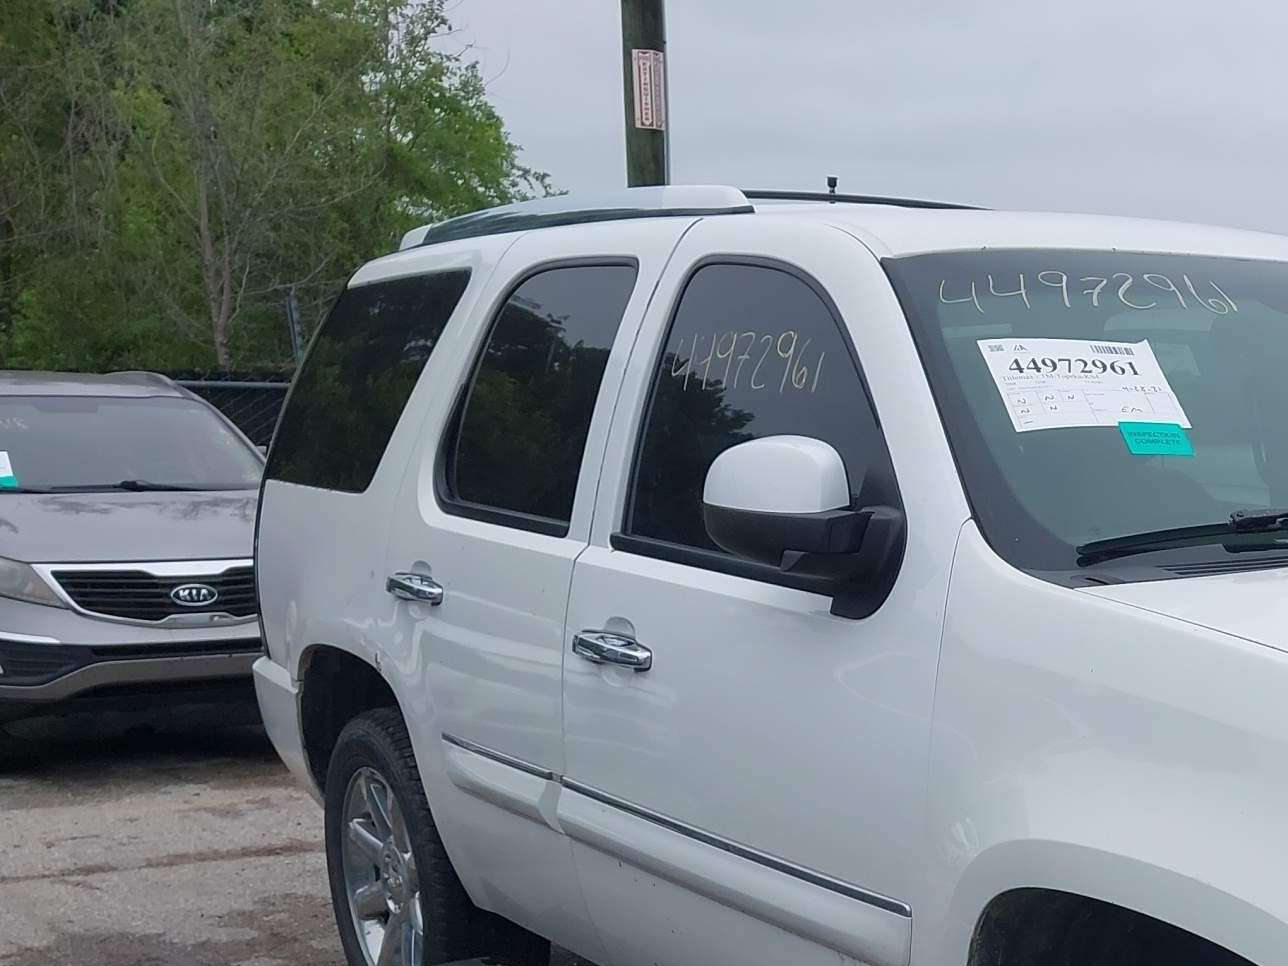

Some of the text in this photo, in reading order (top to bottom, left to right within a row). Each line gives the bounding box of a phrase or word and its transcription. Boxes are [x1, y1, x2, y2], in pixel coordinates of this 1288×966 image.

[939, 270, 1239, 315] 44972961
[671, 330, 825, 393] 44972961
[1009, 357, 1140, 376] 44972961
[1128, 431, 1181, 439] INSPECTION
[1134, 438, 1182, 446] COMPLETE
[178, 588, 210, 601] KIA
